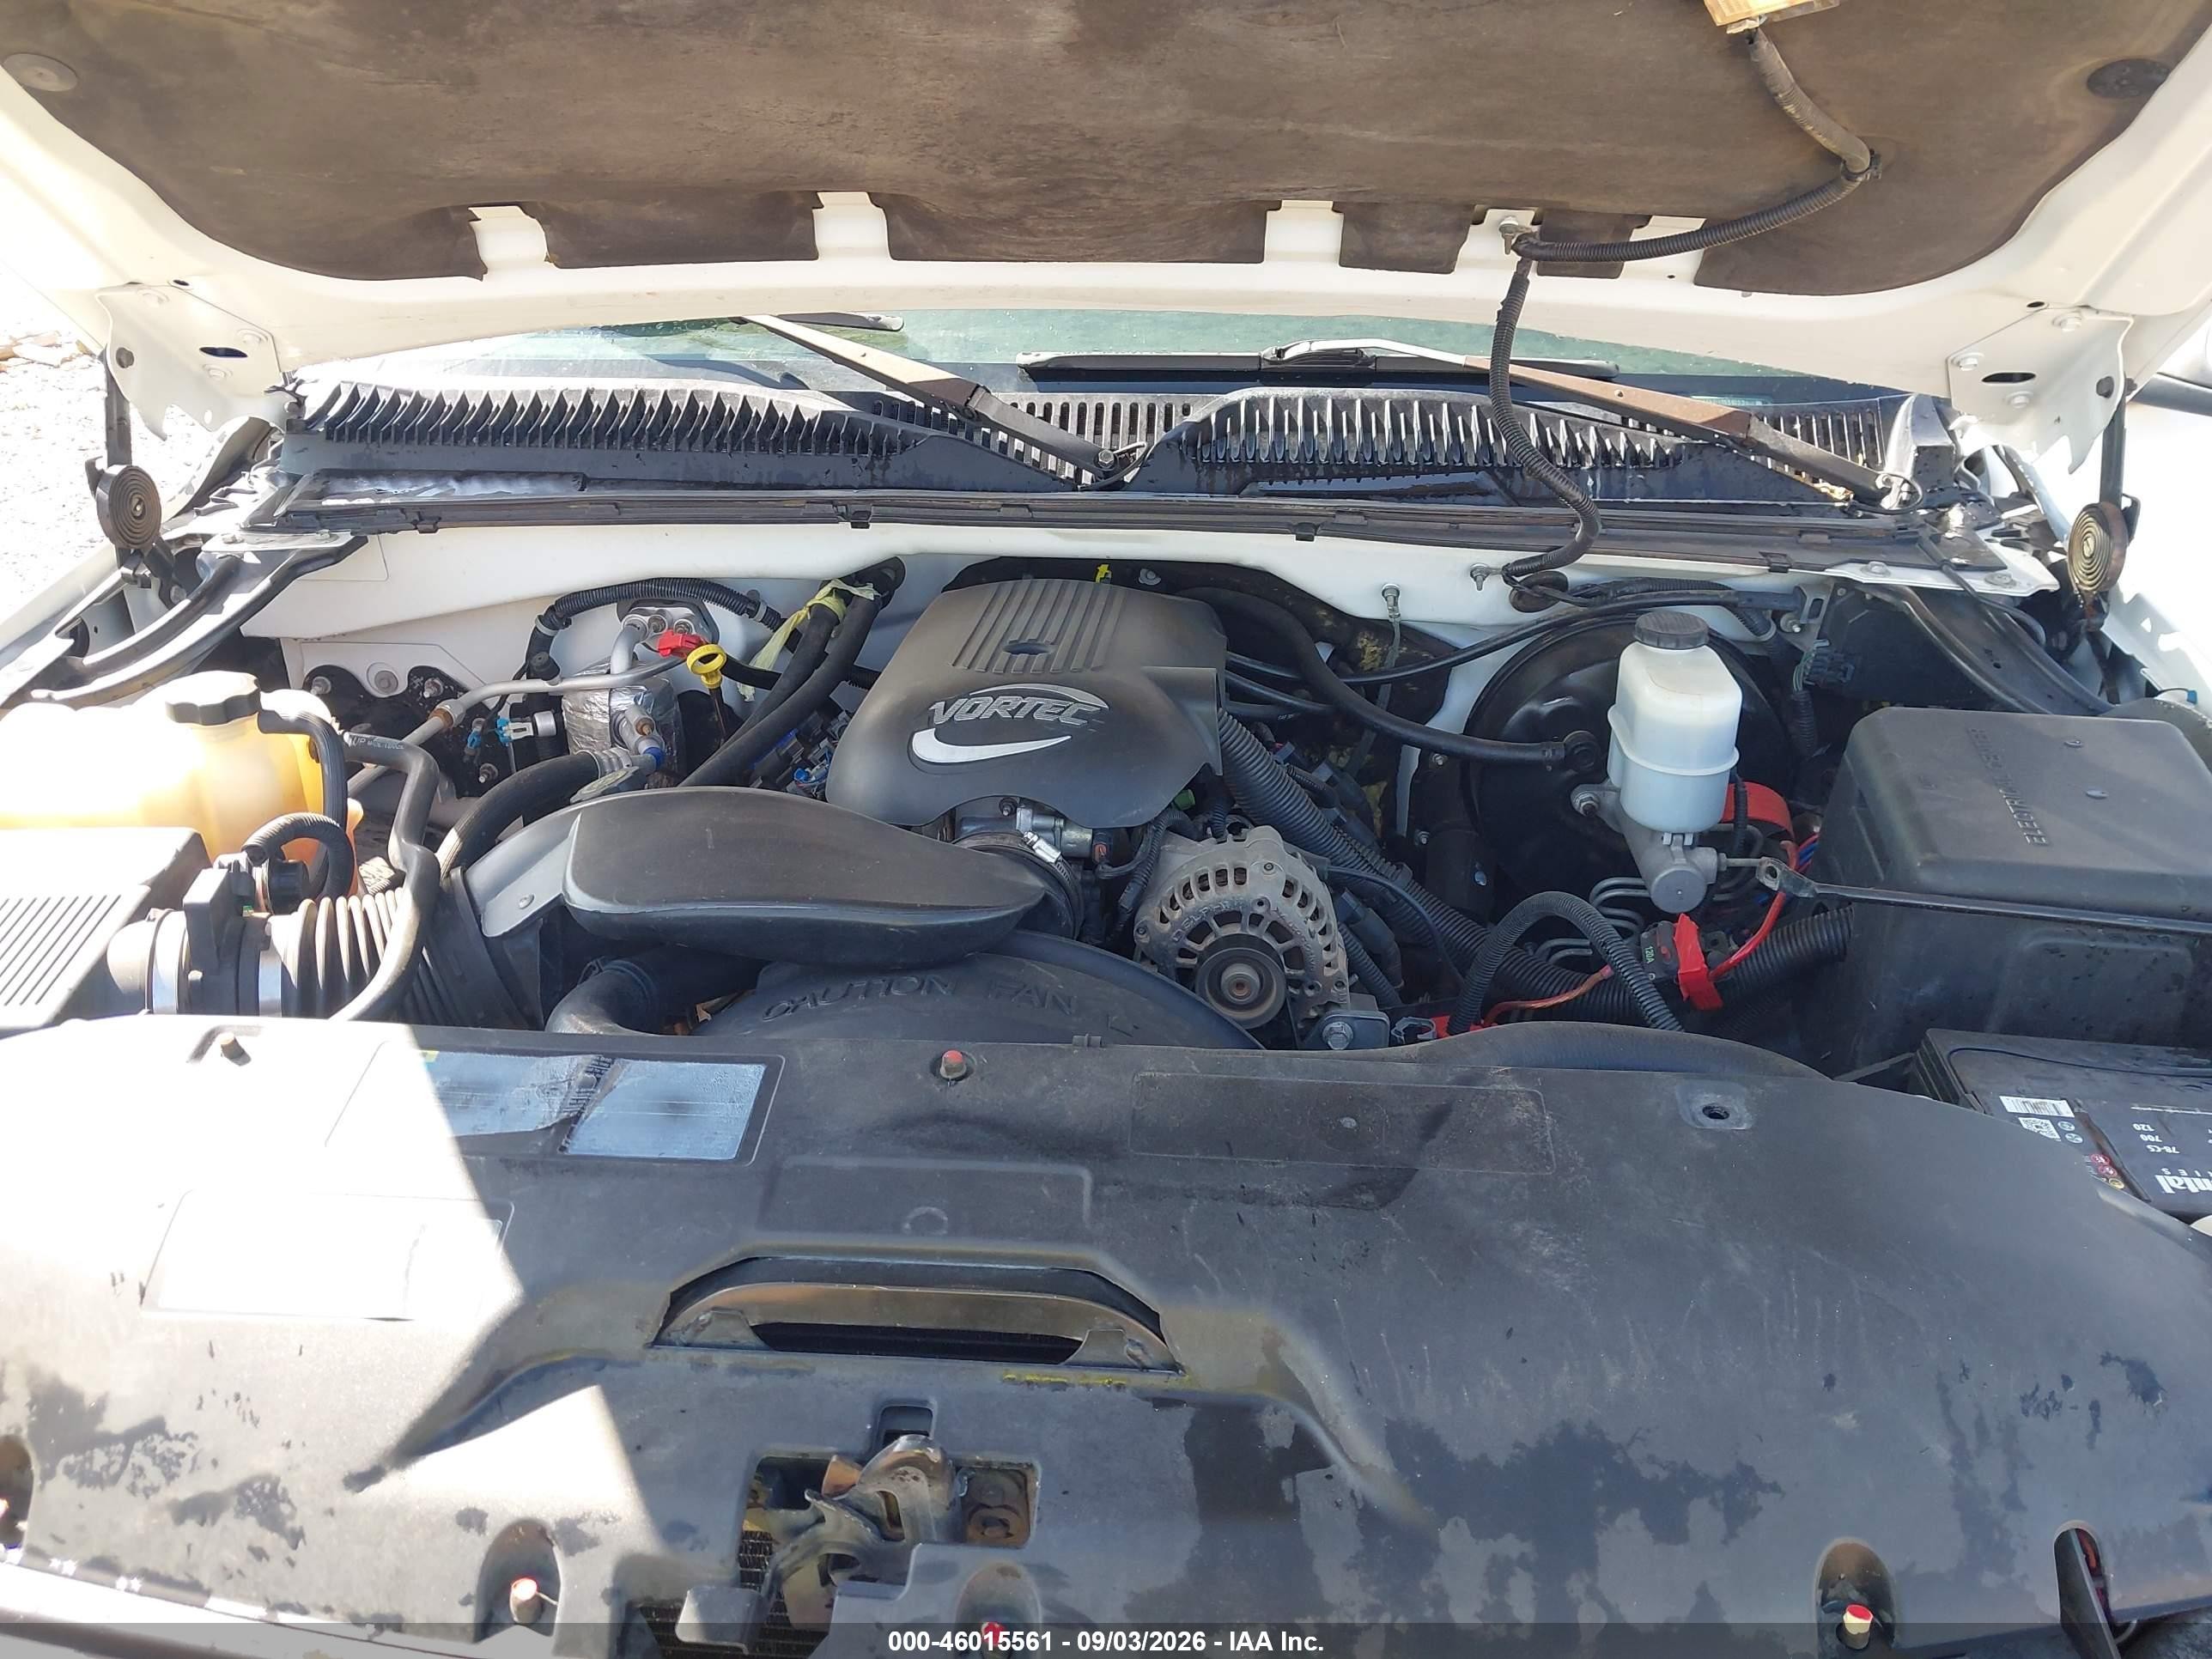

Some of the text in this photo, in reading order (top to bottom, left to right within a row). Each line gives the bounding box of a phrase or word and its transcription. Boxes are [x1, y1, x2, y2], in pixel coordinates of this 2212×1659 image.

[928, 696, 1101, 726] VORTEC
[1644, 945, 1655, 963] 120A
[762, 975, 1077, 1022] CAUTION FAN
[2132, 1123, 2154, 1132] 120
[2139, 1133, 2162, 1143] 700
[2146, 1144, 2180, 1154] 78-CS
